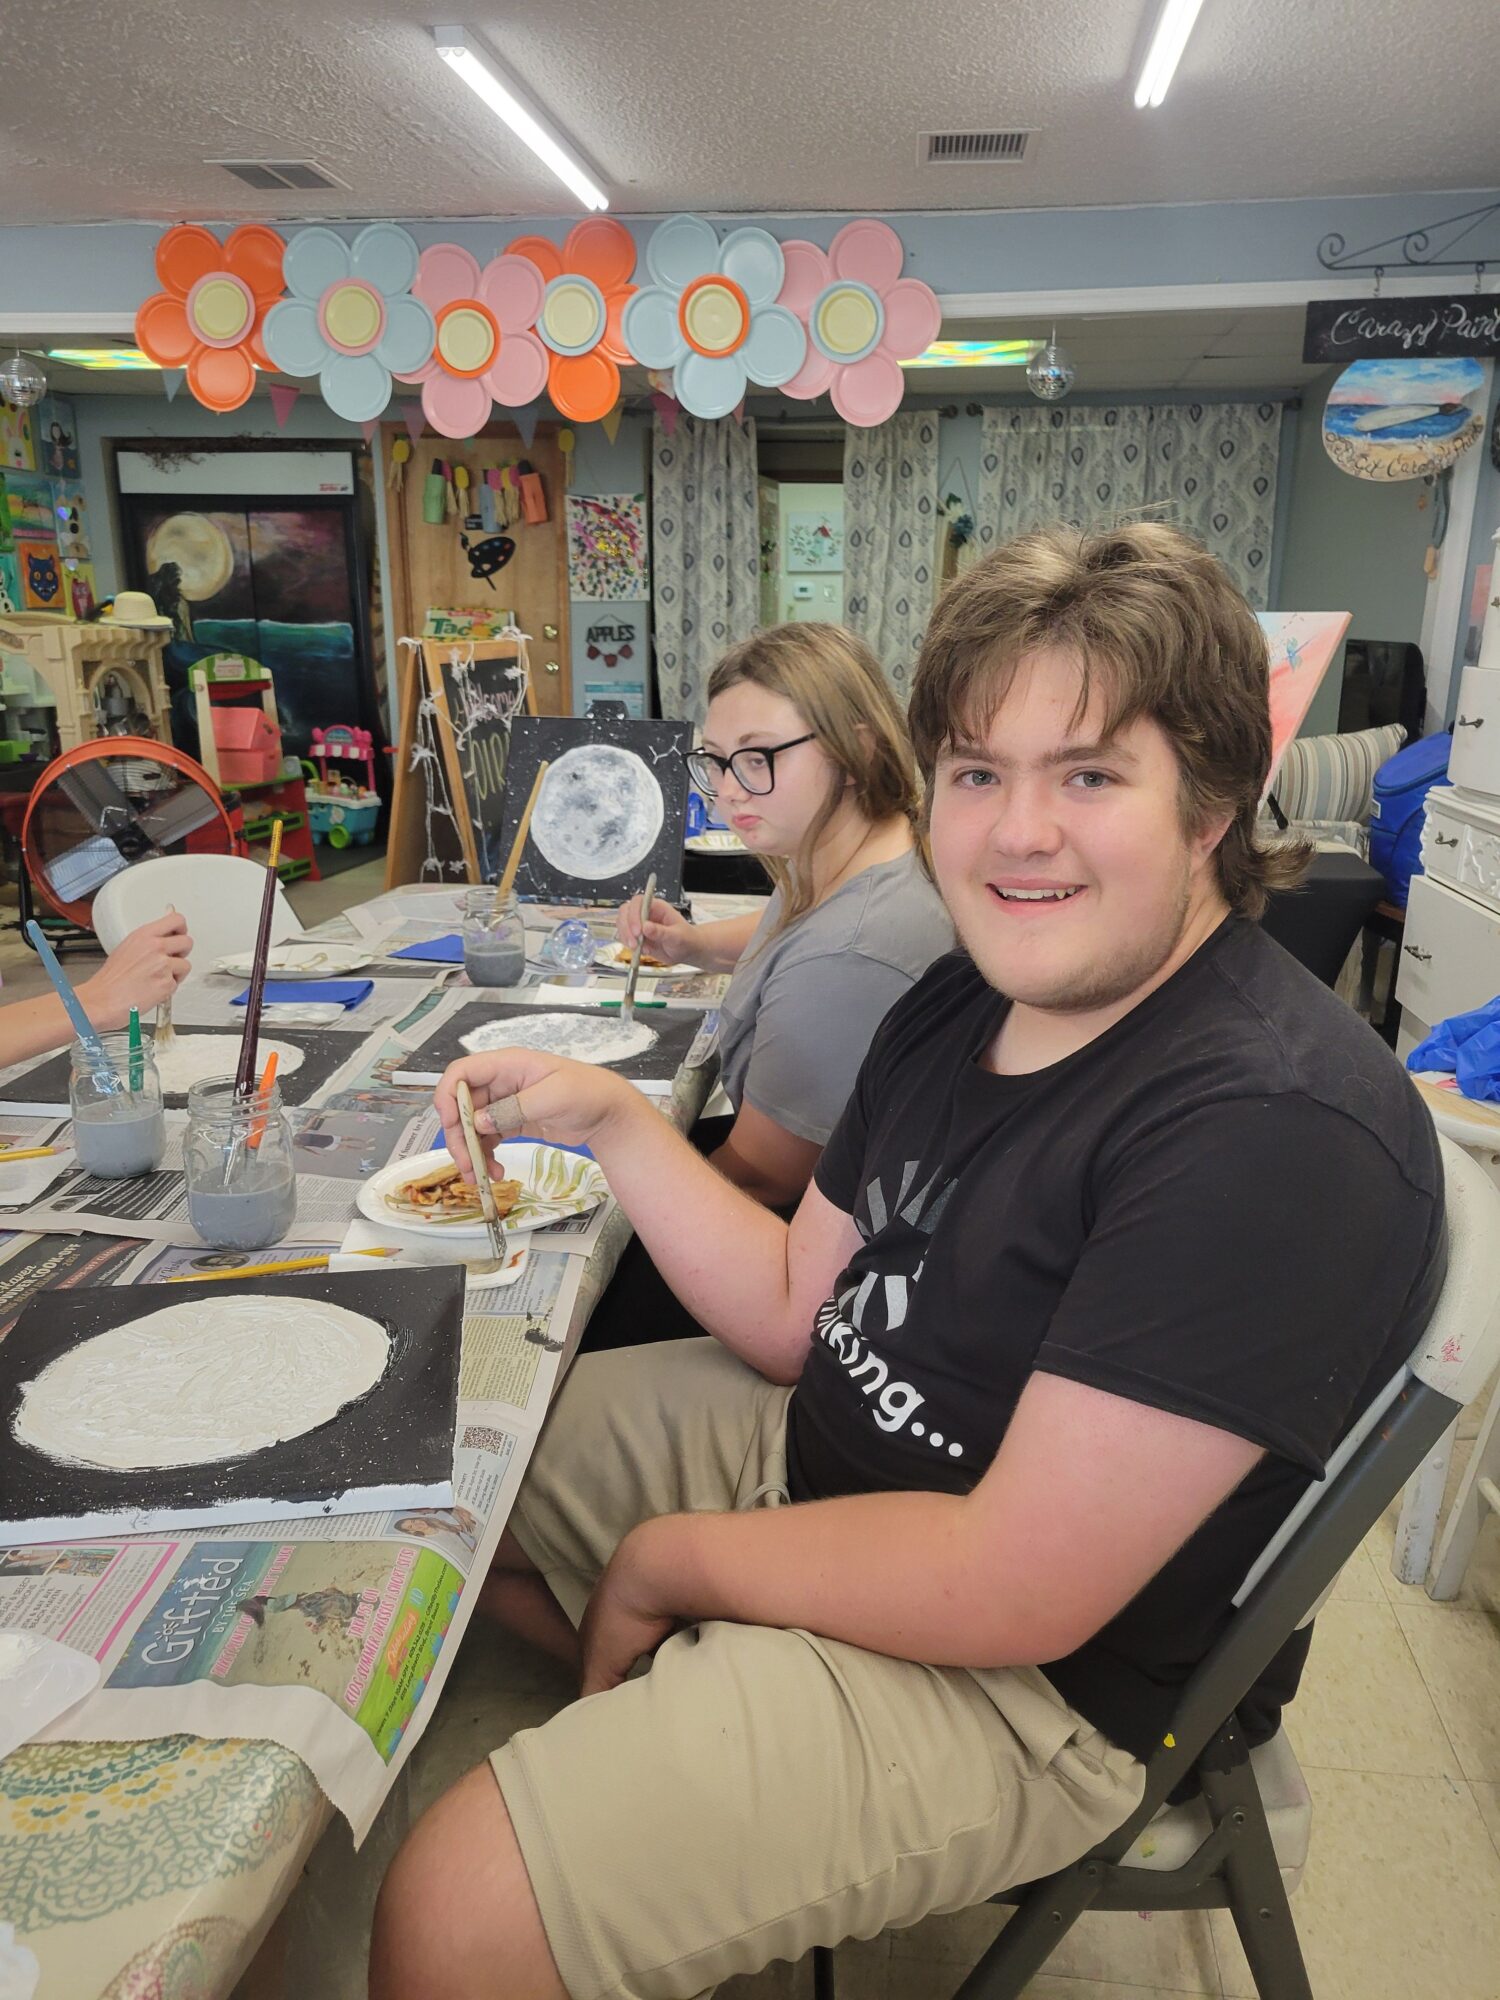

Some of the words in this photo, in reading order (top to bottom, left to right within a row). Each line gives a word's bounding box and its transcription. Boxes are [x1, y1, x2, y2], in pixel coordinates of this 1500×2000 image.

[586, 625, 636, 642] APPLES
[142, 1559, 244, 1664] Gifted
[212, 1618, 227, 1633] BY
[223, 1600, 237, 1617] THE
[235, 1578, 254, 1598] SEA
[349, 1617, 367, 1637] TAKE
[346, 1676, 364, 1705] KIDS
[357, 1634, 380, 1680] SUMMER
[372, 1600, 395, 1637] DRESSES
[388, 1567, 406, 1595] SHORT
